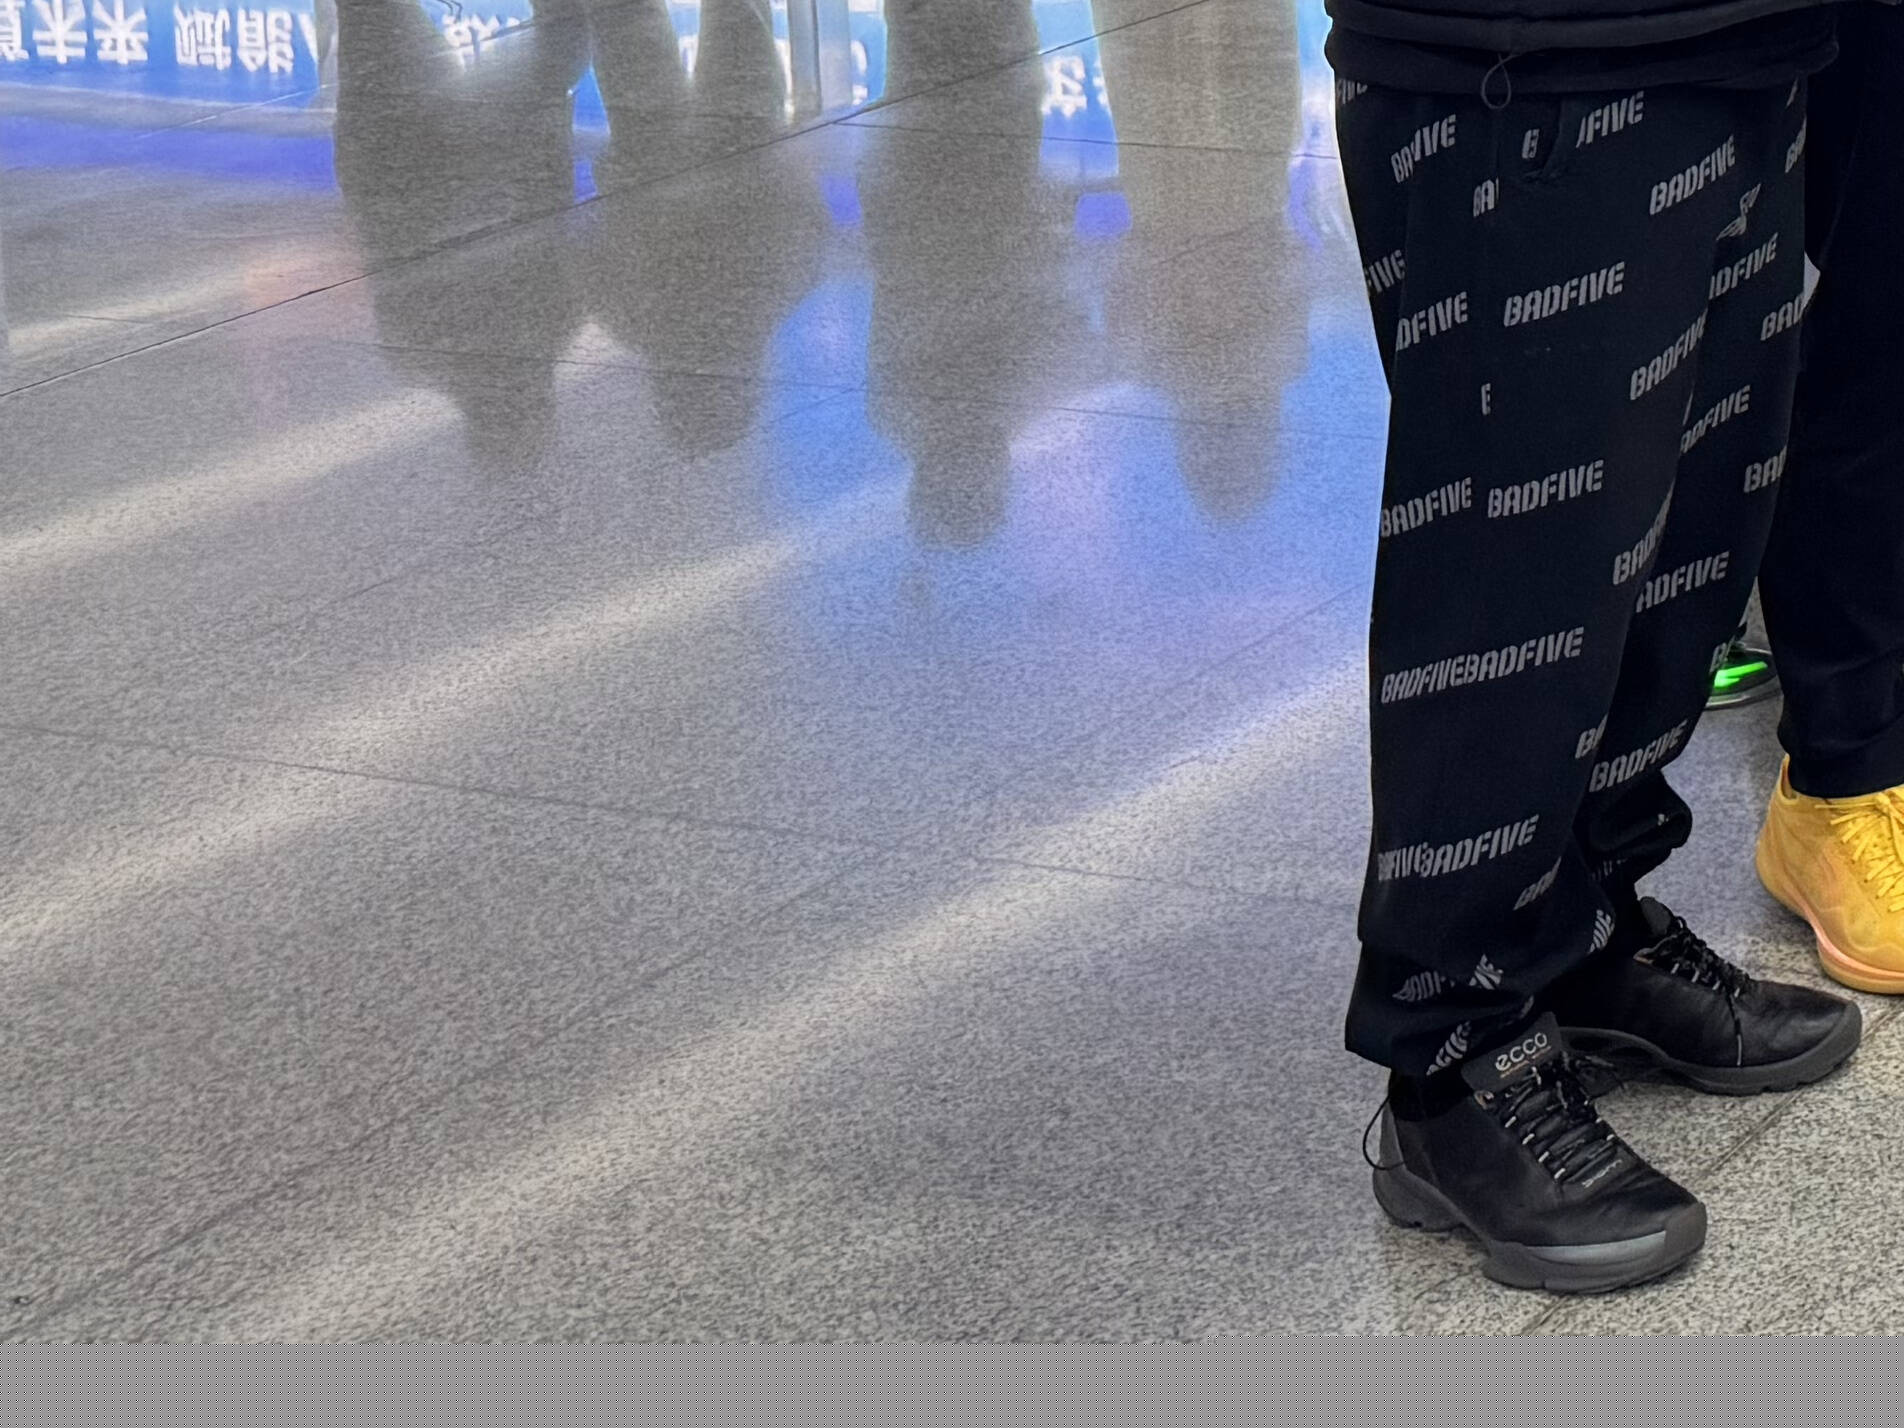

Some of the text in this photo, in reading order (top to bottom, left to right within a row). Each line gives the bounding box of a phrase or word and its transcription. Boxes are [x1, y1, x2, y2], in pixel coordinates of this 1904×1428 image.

[1502, 261, 1626, 327] BADFIVE
[1381, 476, 1472, 538] BADFIVE
[1487, 459, 1605, 519] BADFIVE
[1635, 551, 1729, 613] ADFIVE
[1463, 626, 1585, 685] BADFIVE
[1588, 719, 1688, 793] BADFIVE
[1493, 1030, 1548, 1074] ecco
